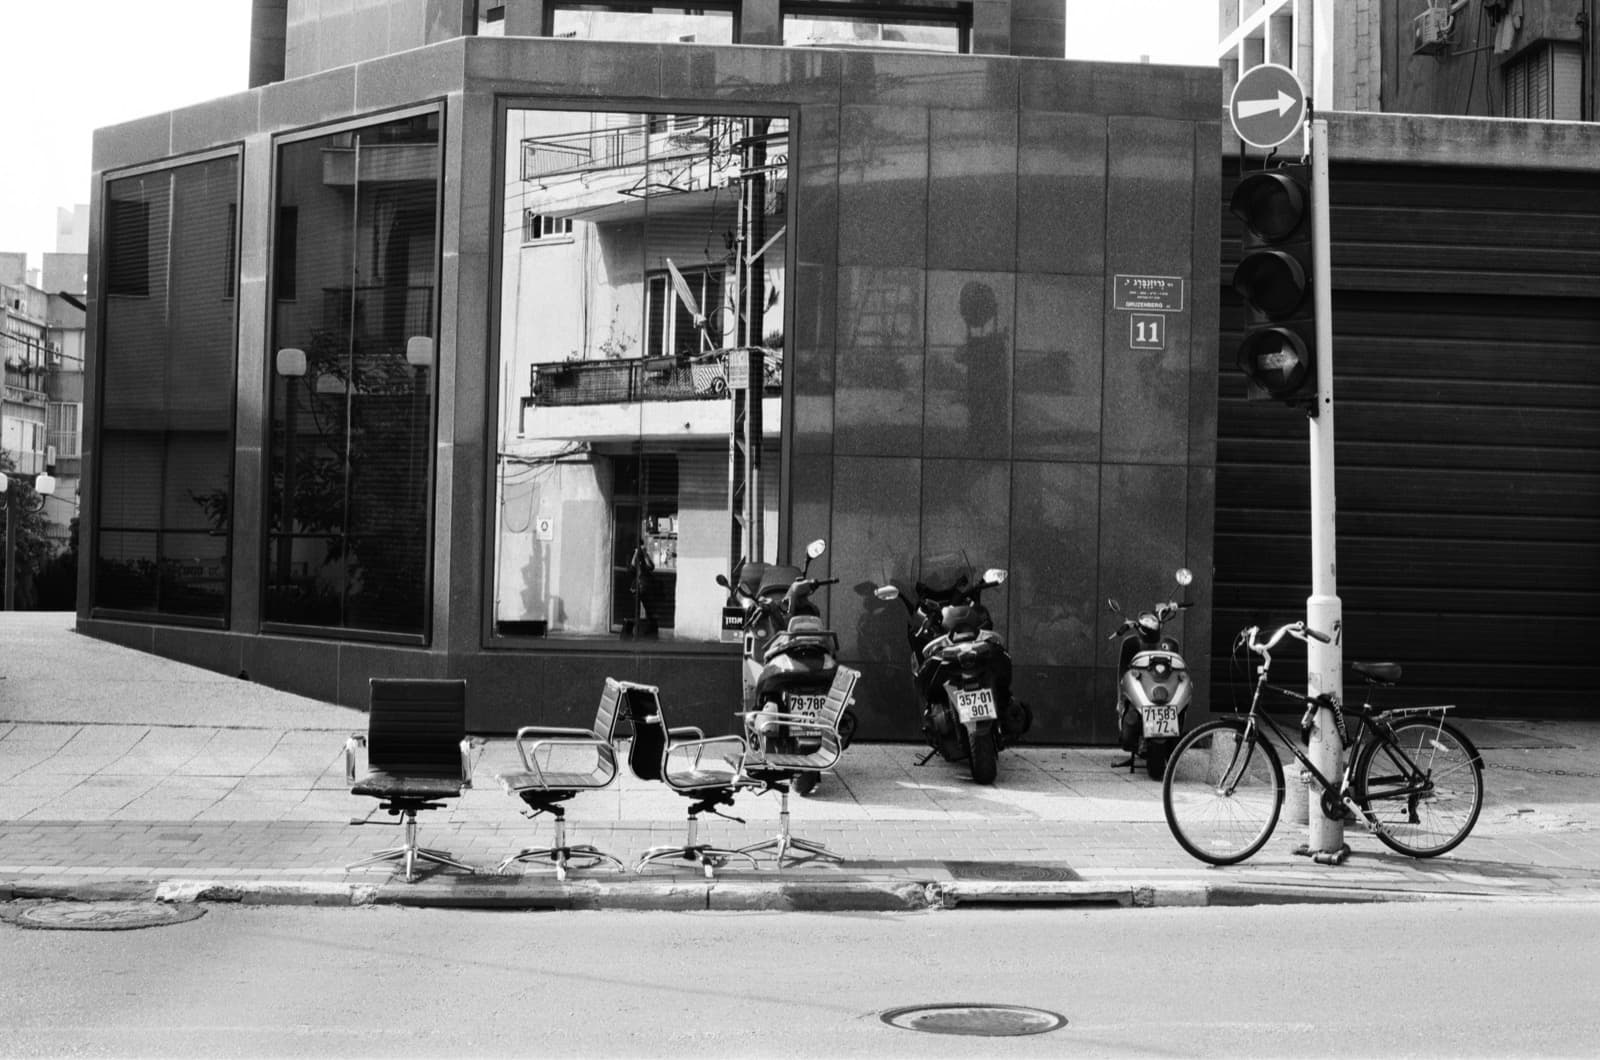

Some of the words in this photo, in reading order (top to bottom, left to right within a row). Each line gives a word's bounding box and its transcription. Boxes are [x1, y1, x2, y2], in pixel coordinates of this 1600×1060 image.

[1135, 321, 1159, 342] 11
[971, 704, 989, 717] 901
[1156, 720, 1170, 733] 72
